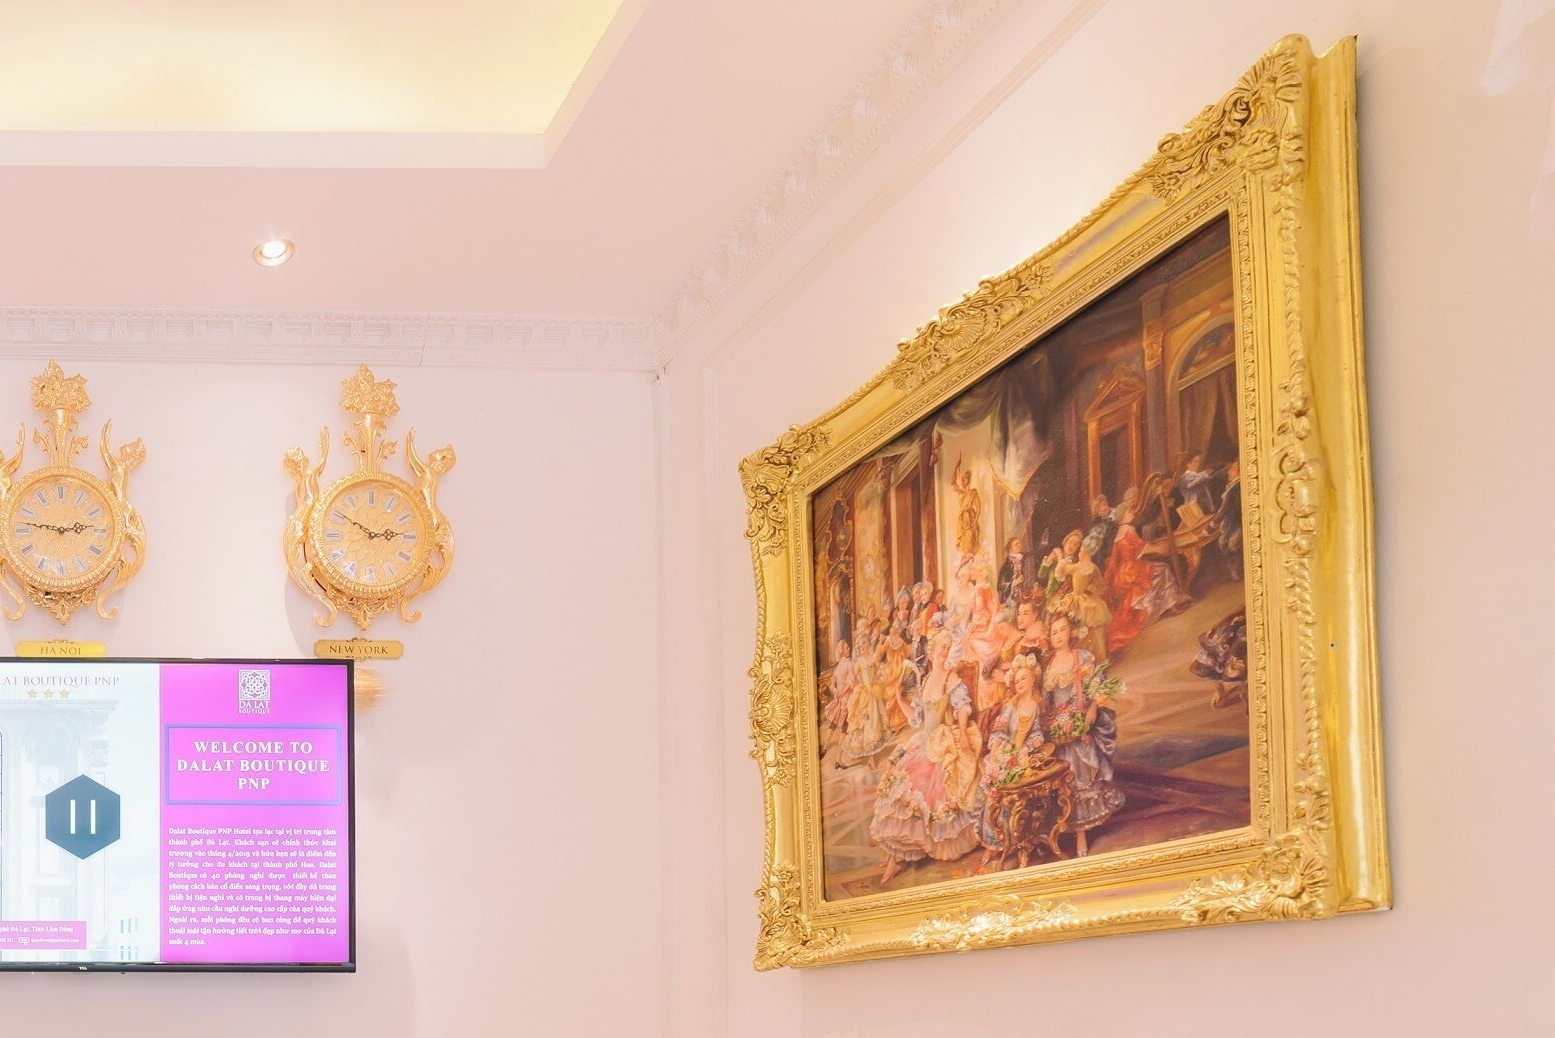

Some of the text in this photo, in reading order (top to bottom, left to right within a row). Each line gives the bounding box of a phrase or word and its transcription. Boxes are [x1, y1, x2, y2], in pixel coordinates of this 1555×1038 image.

[40, 646, 81, 655] HA NOI
[330, 644, 388, 654] NEW YORK
[24, 676, 90, 688] BOUTIQUE
[94, 676, 120, 686] PNP
[239, 701, 270, 709] DA LAT
[193, 742, 313, 754] WELCOME TO
[178, 760, 330, 774] DALAT BOUTIQUE
[238, 778, 270, 790] PNP
[188, 828, 216, 836] Boutique
